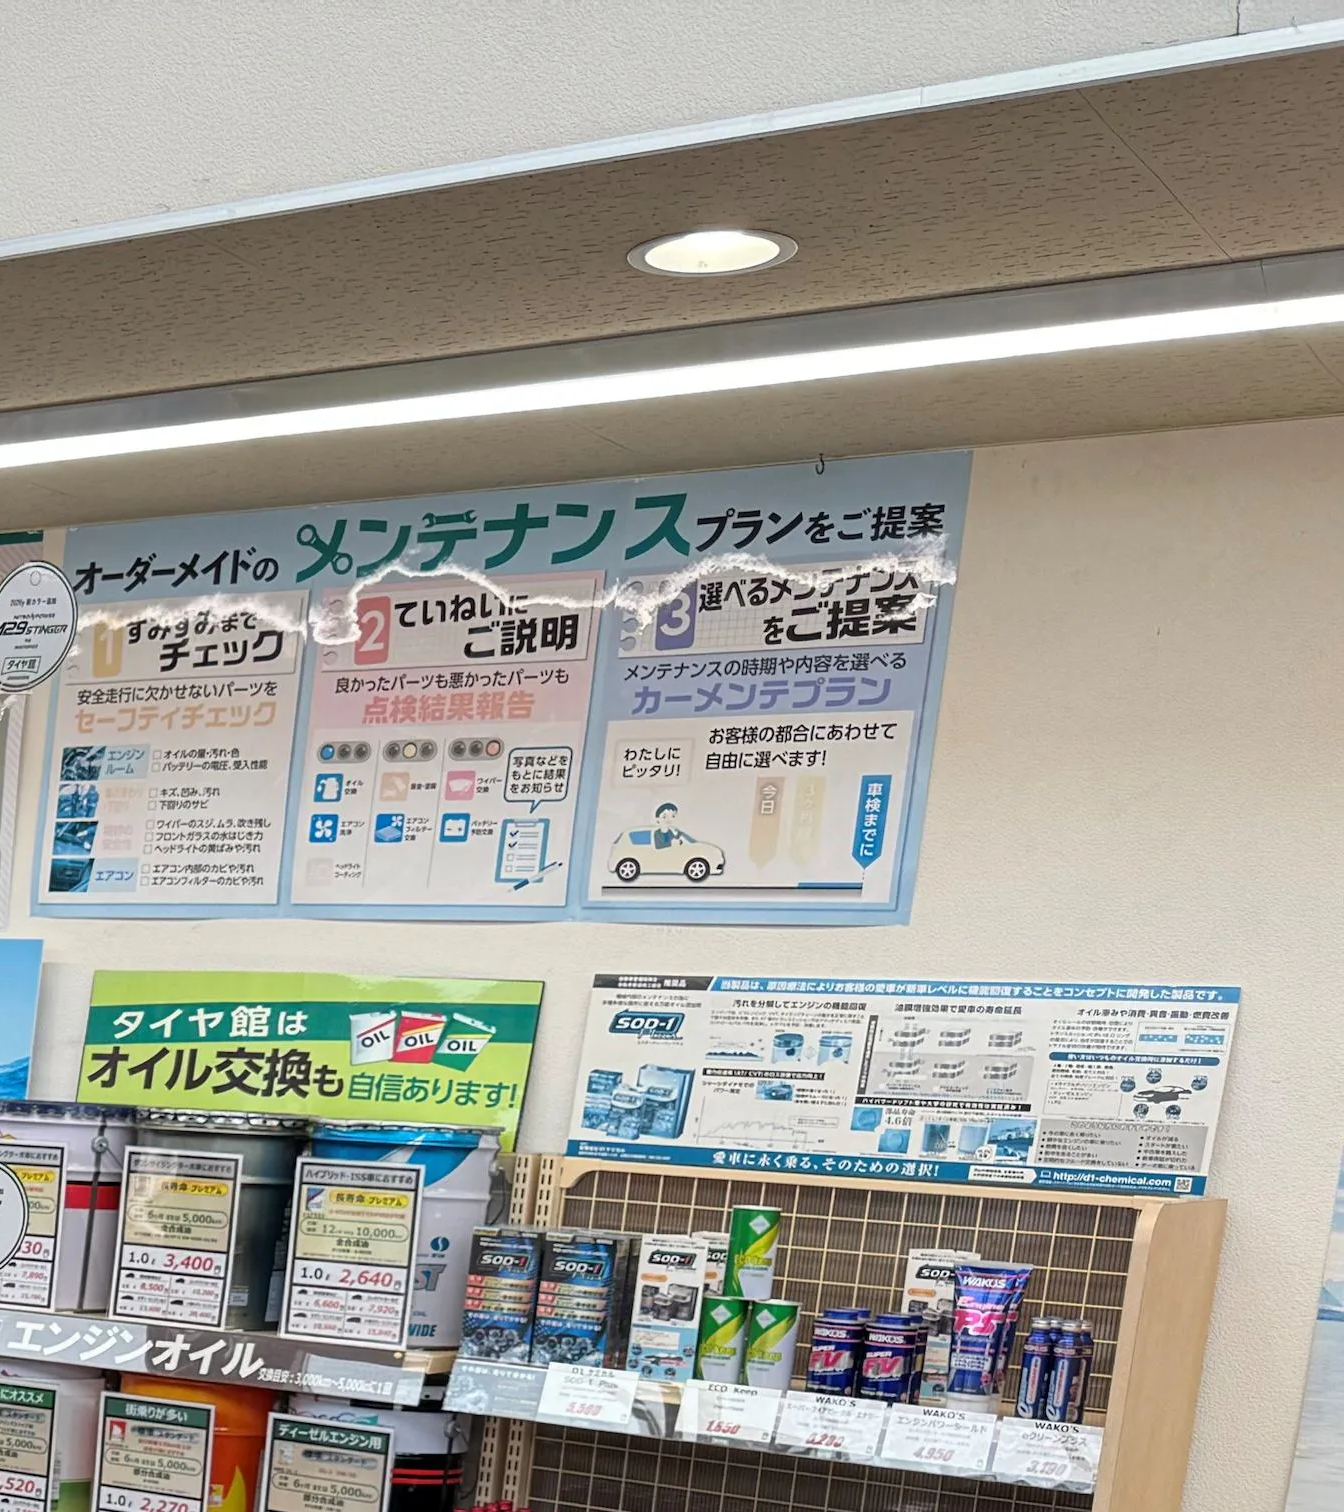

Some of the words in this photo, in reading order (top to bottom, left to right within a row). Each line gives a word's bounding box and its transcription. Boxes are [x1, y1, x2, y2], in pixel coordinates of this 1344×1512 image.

[74, 547, 279, 594] オーダーメイドの
[295, 492, 691, 583] メンテナンス
[696, 503, 946, 553] プランをご提案
[463, 614, 579, 659] ご説明
[159, 631, 283, 671] チェック
[7, 659, 37, 670] タイヤ館
[623, 652, 907, 682] メンテナンスの時期や内容を選べる
[77, 681, 278, 706] 安全走行に欠かせないパーツを
[630, 676, 892, 715] カーメンテプラン
[361, 689, 536, 725] 点検結果報告
[75, 701, 278, 735] セーフティチェック
[709, 722, 898, 745] お客様の都合にあわせて
[107, 751, 145, 761] エンジン
[513, 755, 568, 767] 写真などを
[623, 747, 681, 762] わたしに
[705, 750, 827, 771] 自由に選べます!
[106, 766, 134, 775] ルーム
[512, 769, 566, 780] もとに結果
[622, 763, 681, 780] ピッタリ!
[510, 783, 564, 794] をお知らせ
[760, 785, 776, 816] 今日
[858, 782, 884, 857] 車検までに
[95, 871, 134, 882] エアコン
[152, 864, 254, 874] エアコン内部のカビや汚れ
[151, 877, 263, 886] エアコンフィルターのカビや汚れ
[112, 1004, 309, 1040] タイヤ館は
[615, 1016, 674, 1030] SOD-1
[360, 1028, 391, 1049] OIL
[404, 1033, 435, 1048] OIL
[446, 1038, 478, 1054] OIL
[86, 1045, 344, 1099] オイル交換も
[347, 1071, 518, 1109] 自信あります!
[1053, 1171, 1172, 1187] http://d1-chemical.com
[479, 1254, 526, 1267] SOD-1
[552, 1260, 601, 1274] SOD-1
[7, 1319, 265, 1379] エンジンオイル
[125, 1404, 188, 1421] 街乗りが多い
[923, 1408, 966, 1421] WAKO'S
[1035, 1421, 1080, 1434] WAKO'S
[276, 1423, 382, 1451] ディーゼルエンジン用
